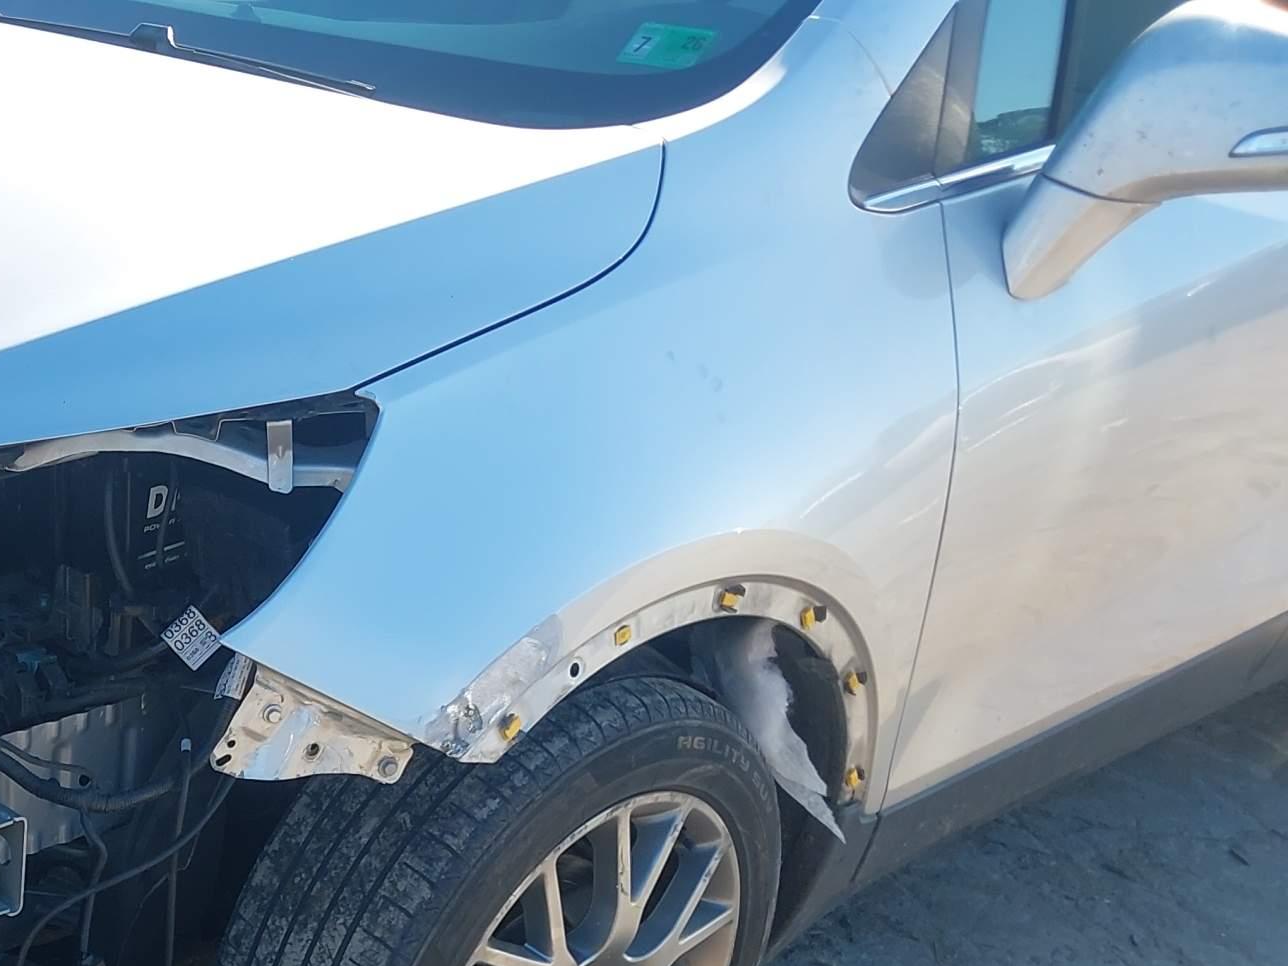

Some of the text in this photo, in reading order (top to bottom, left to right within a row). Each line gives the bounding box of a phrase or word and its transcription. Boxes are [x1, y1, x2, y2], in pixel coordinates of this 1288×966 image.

[633, 36, 652, 52] 7
[163, 608, 196, 640] 0368
[173, 619, 206, 652] 0368
[676, 736, 750, 772] AGILITY
